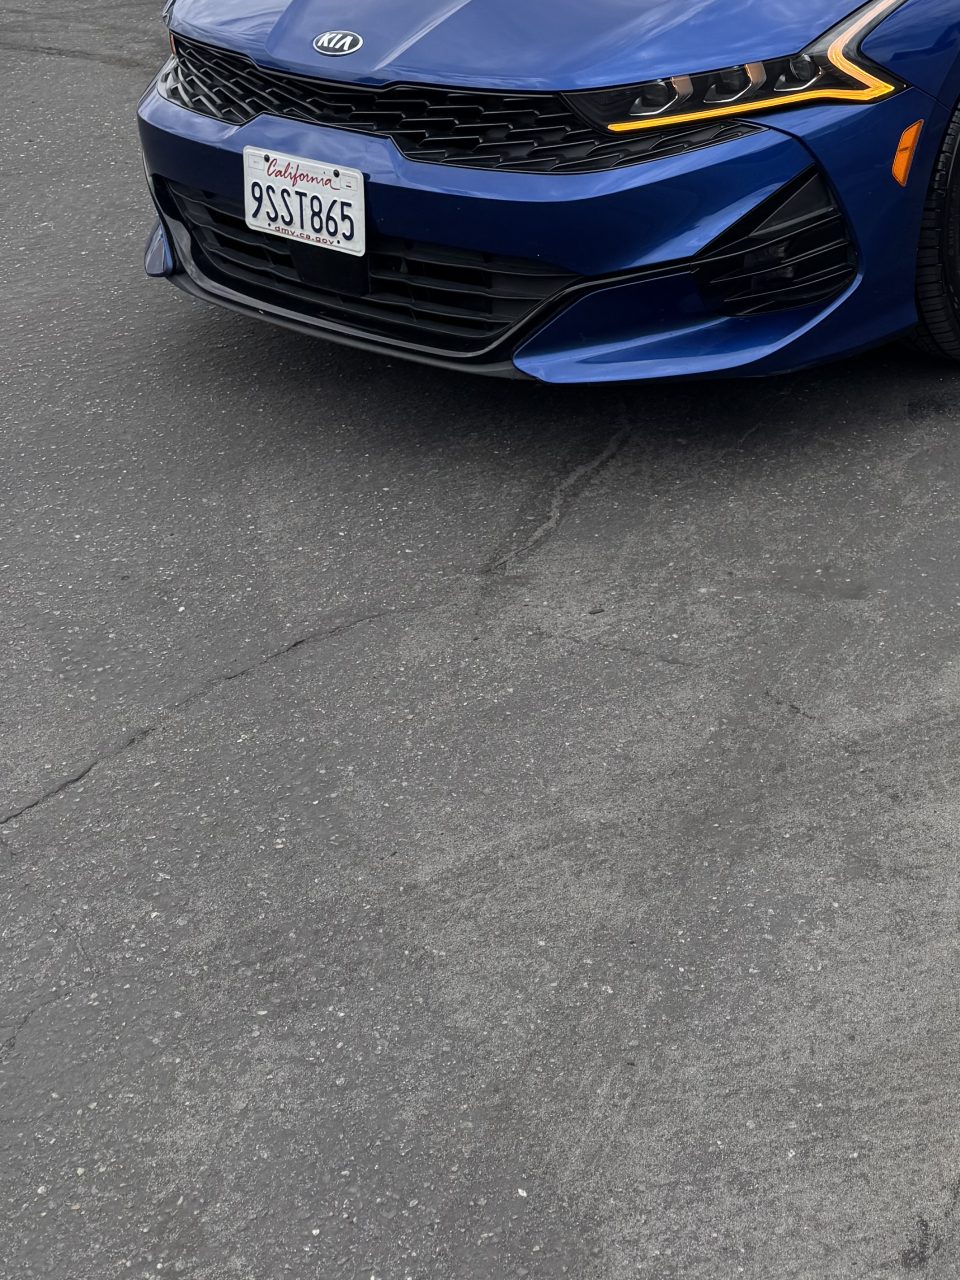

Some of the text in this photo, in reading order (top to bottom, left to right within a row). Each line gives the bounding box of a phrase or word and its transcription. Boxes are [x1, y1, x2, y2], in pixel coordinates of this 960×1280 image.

[317, 32, 353, 51] KIA
[266, 158, 341, 191] California
[251, 181, 355, 241] 9SST865
[274, 225, 335, 245] dmv.ca.gov
